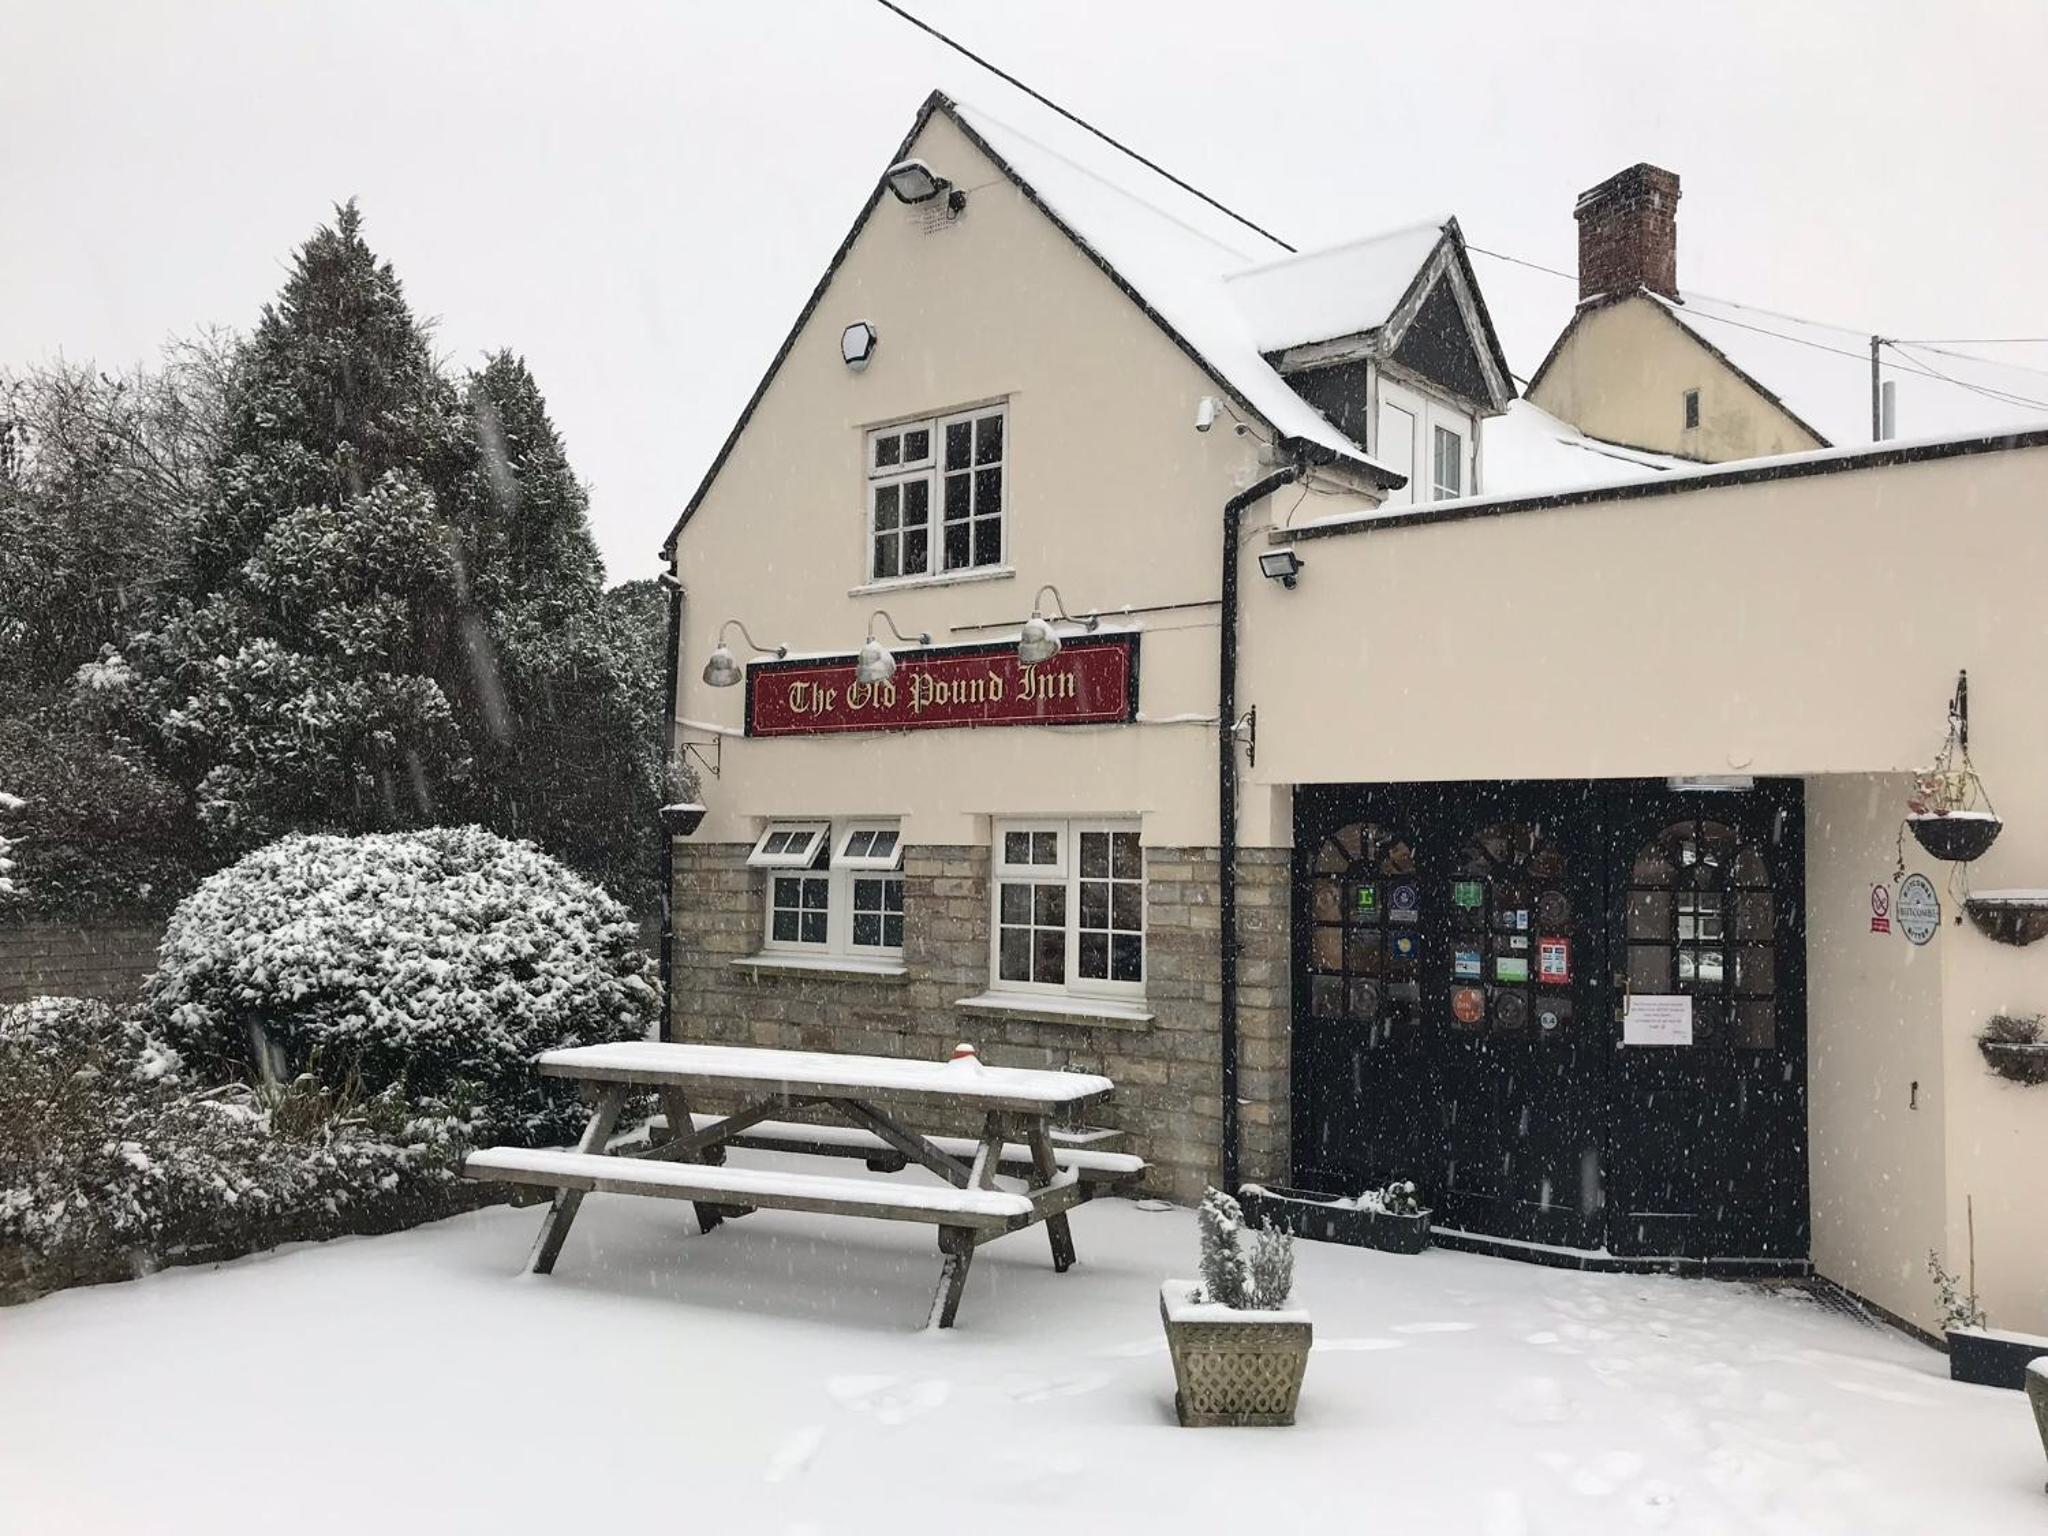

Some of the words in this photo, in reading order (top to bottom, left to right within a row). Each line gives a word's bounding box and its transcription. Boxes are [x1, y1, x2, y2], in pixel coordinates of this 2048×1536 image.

[788, 680, 837, 717] The
[847, 679, 897, 710] Old
[908, 669, 1004, 715] Pound
[1016, 663, 1077, 702] Inn
